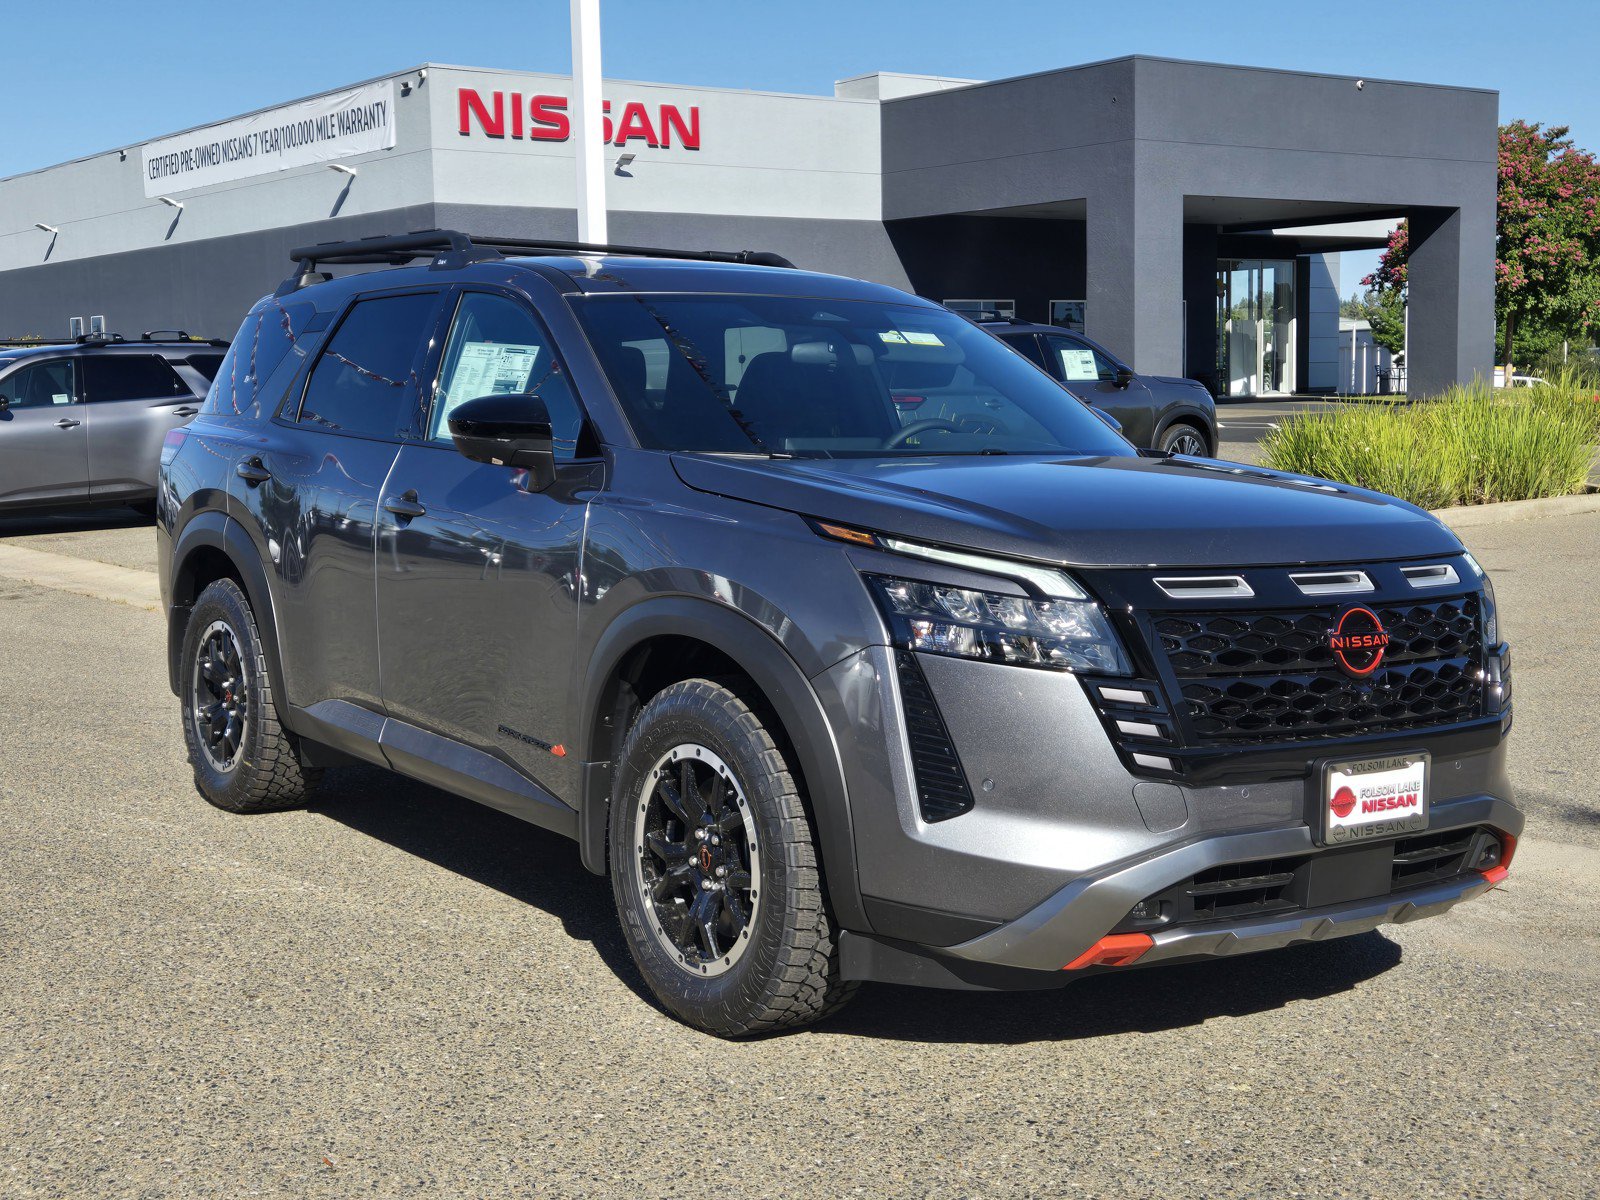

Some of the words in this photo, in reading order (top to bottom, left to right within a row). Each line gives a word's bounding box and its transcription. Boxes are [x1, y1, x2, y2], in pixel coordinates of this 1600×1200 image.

[458, 88, 700, 151] NISAN
[148, 151, 180, 180] CERTIFIED
[180, 143, 221, 173] PRE-OWNED
[221, 133, 252, 163] NISSANS
[253, 132, 258, 156] 7
[316, 112, 336, 142] MILE
[336, 100, 387, 136] WARRANTY
[1331, 634, 1389, 649] NISSAN
[1351, 760, 1385, 773] FOLSOM
[1386, 757, 1408, 769] LAKE
[1359, 785, 1396, 799] FOLSOM
[1397, 781, 1421, 793] LAKE
[1361, 793, 1417, 814] NISSAN
[1350, 821, 1406, 838] NISSAN
